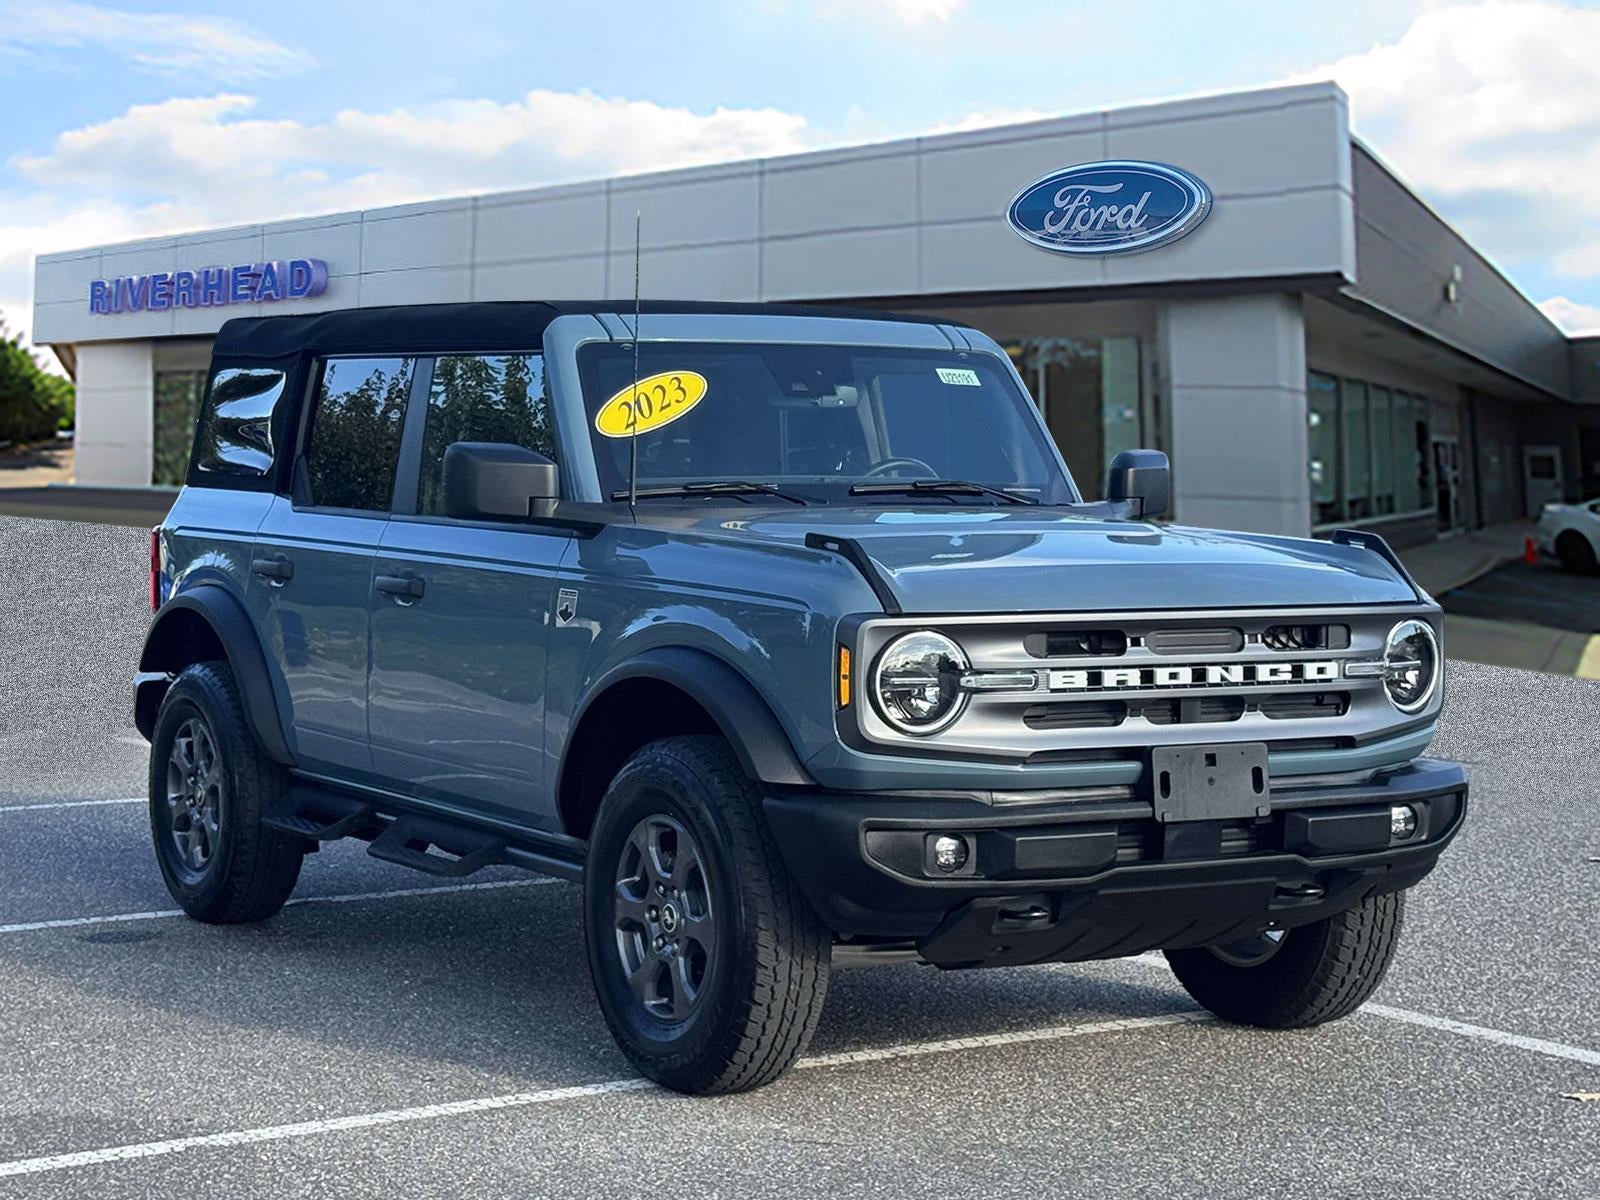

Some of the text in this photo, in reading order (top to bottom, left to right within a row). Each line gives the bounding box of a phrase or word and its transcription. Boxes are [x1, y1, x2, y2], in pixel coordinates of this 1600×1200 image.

[1043, 182, 1152, 233] Ford
[89, 259, 326, 315] RIVERHEAD
[618, 376, 687, 431] 2023
[1049, 661, 1339, 689] BRONCO
